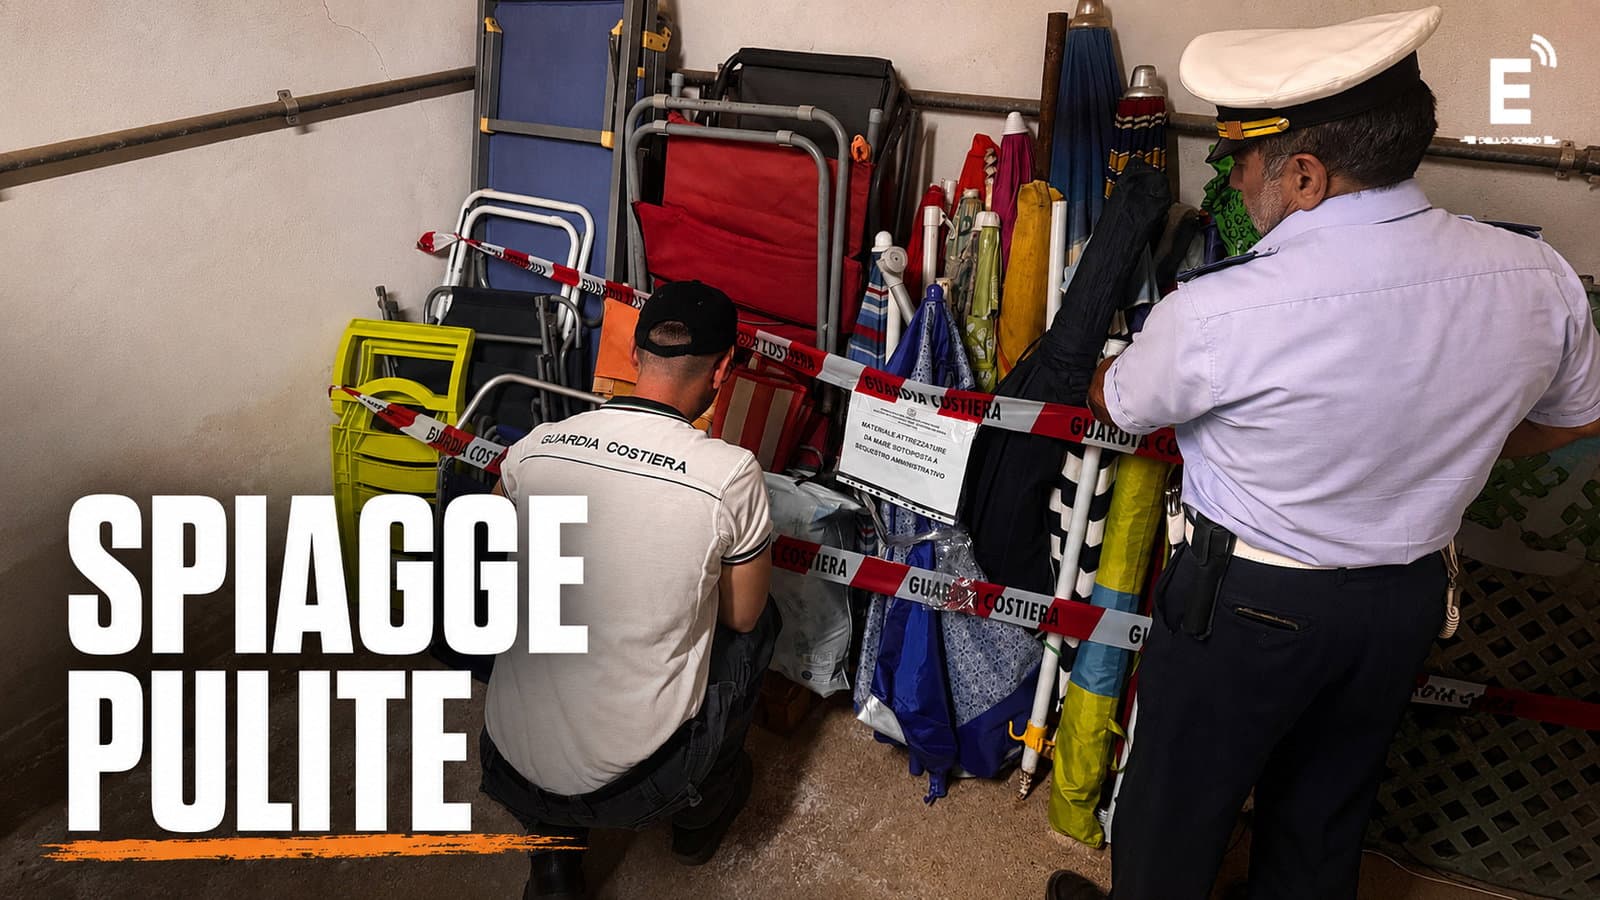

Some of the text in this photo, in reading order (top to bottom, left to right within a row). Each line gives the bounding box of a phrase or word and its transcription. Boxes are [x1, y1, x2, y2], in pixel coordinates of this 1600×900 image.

[864, 375, 928, 406] GUARDIA
[930, 392, 1002, 421] COSTIERA
[861, 421, 897, 438] MATERIALE
[896, 433, 947, 456] ATTREZZATURE
[864, 433, 873, 442] DA
[873, 437, 892, 449] MARE
[892, 444, 932, 462] SOTOPOSTA
[1070, 416, 1149, 451] GUARDIA
[541, 433, 687, 474] GUARDIA COSTIERA
[855, 442, 946, 480] SEQUESTRO AMMINISTRATIVO
[782, 545, 847, 578] COSTIERA
[909, 576, 1060, 627] GUARDA COSTIERA
